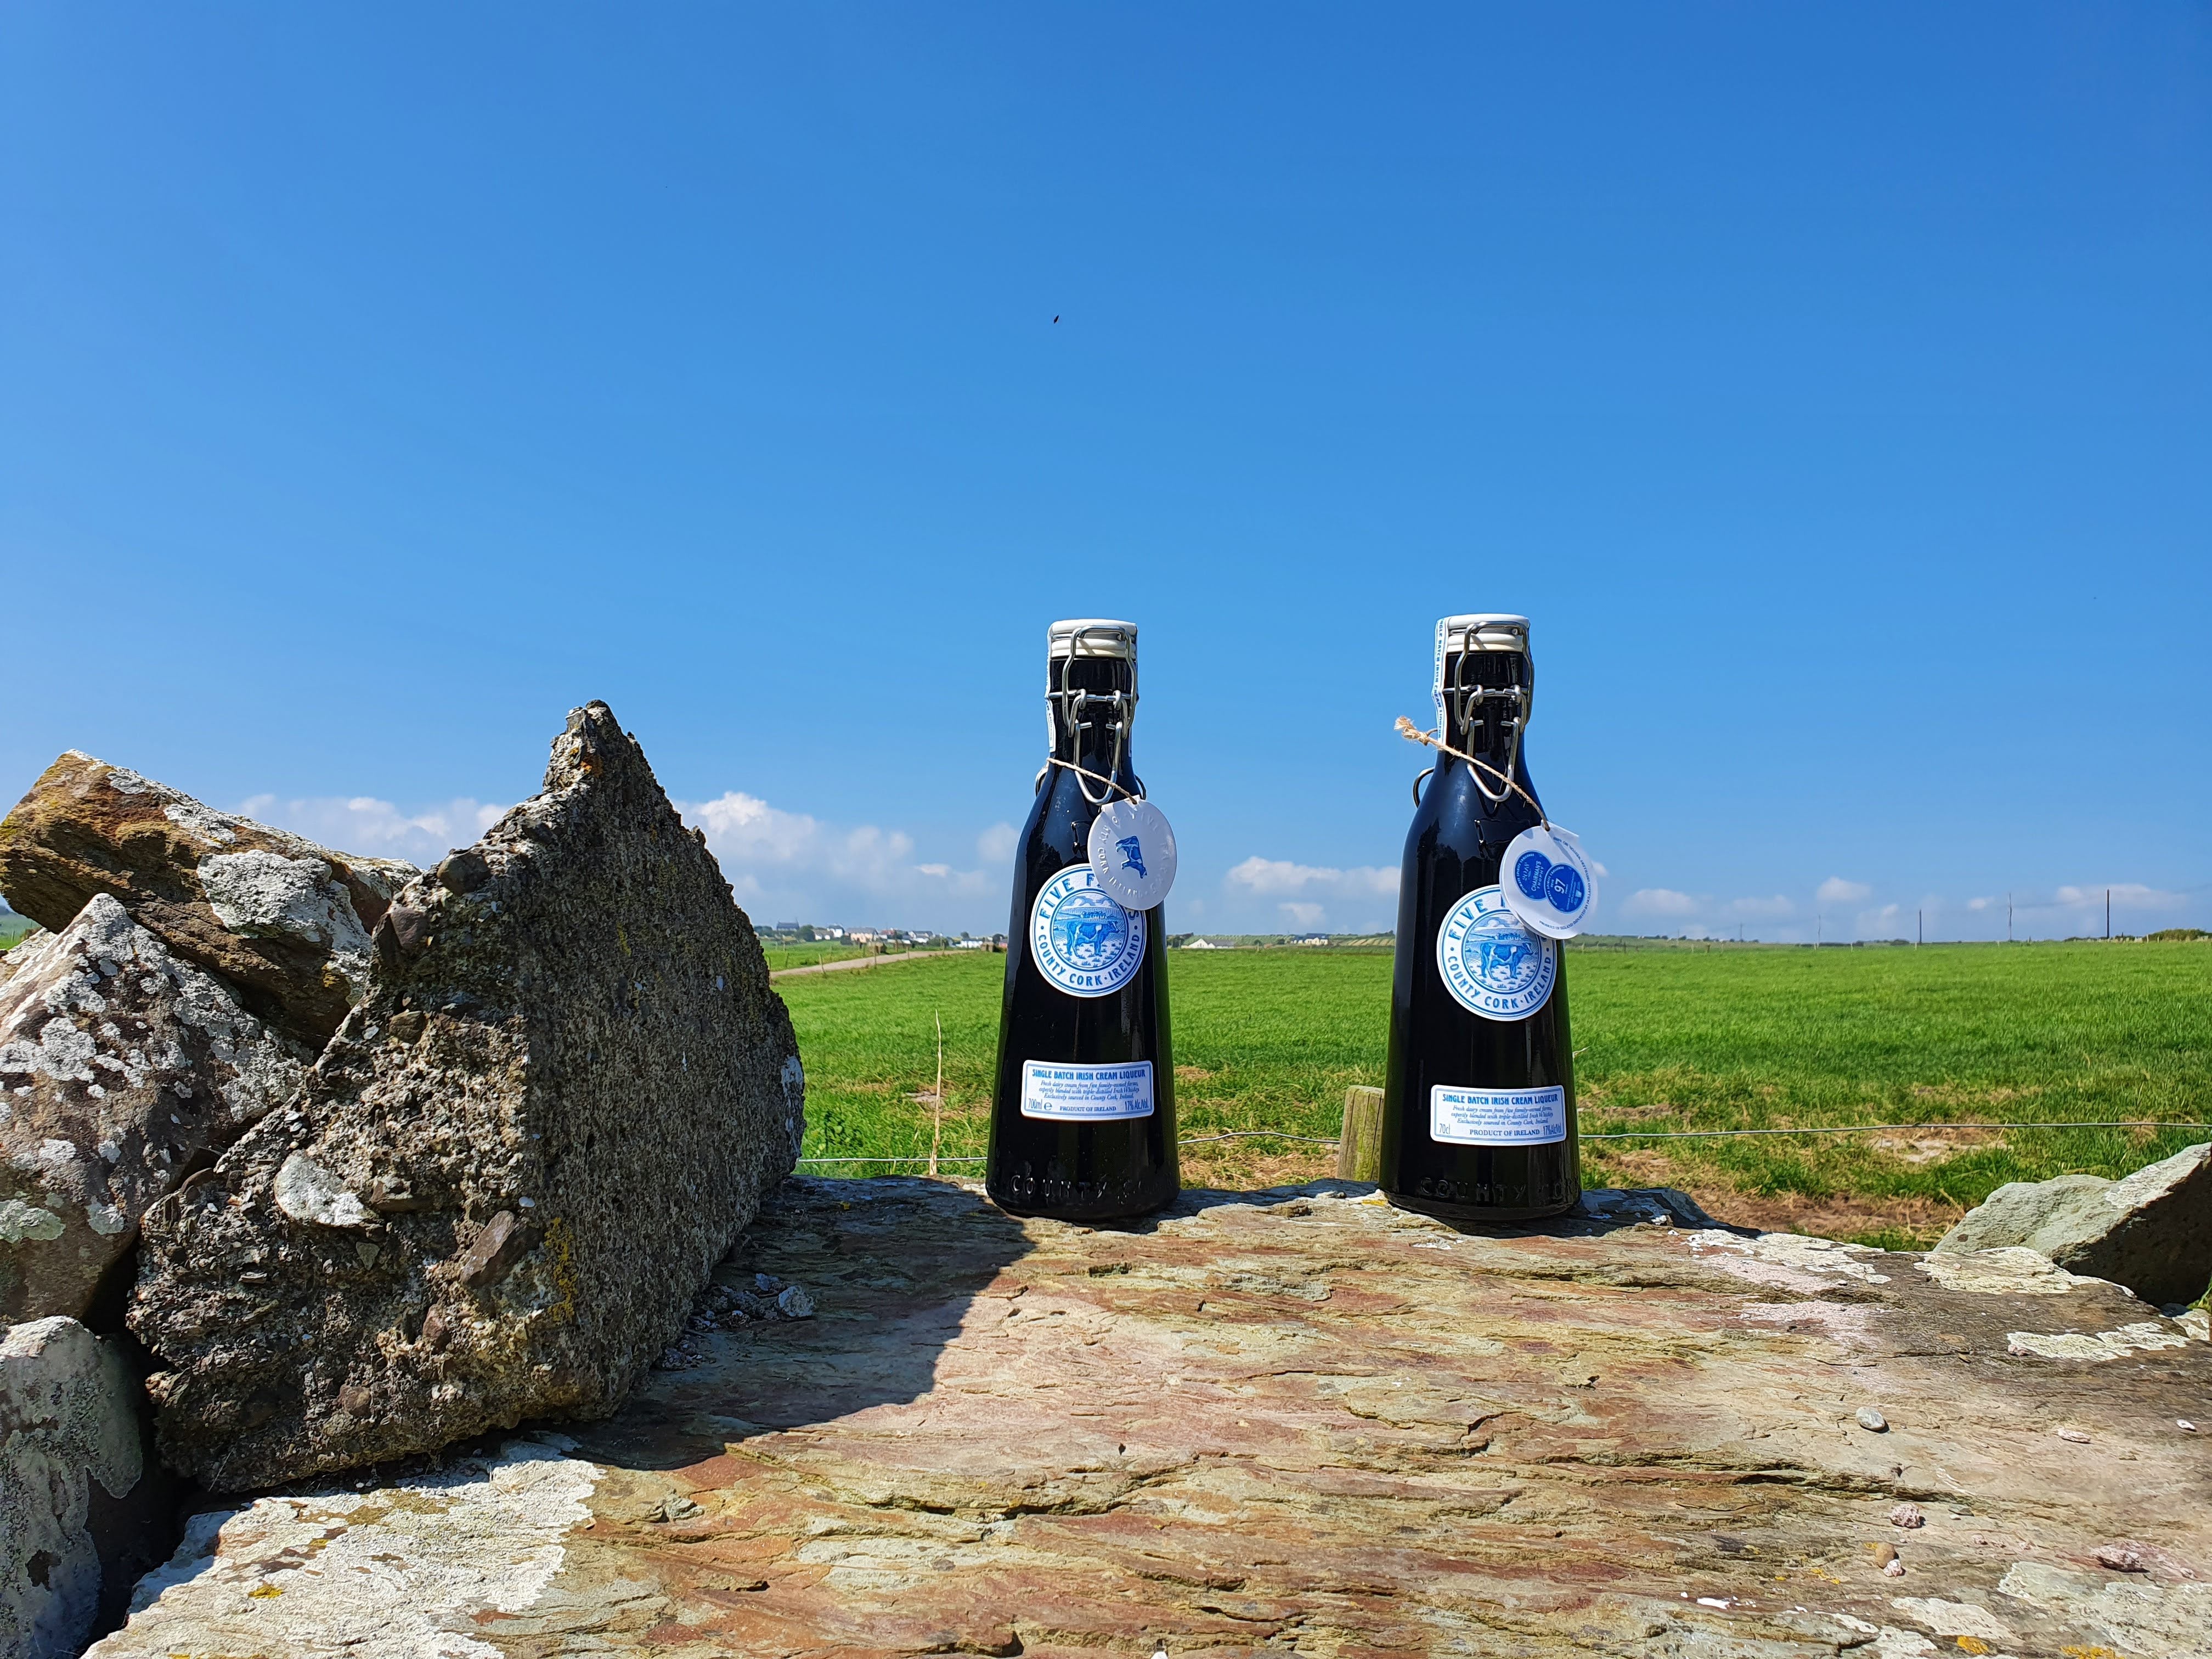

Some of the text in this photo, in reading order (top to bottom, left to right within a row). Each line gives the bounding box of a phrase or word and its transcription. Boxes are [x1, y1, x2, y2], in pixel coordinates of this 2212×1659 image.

[1531, 860, 1541, 891] CHAIRMAN'S
[1554, 878, 1565, 894] 97
[1040, 878, 1074, 919] FIVE
[1449, 899, 1488, 941] FIVE
[1038, 934, 1140, 986] COUNTY CORK IRELAND
[1448, 956, 1551, 1009] COUNTY CORK IRELAND
[1032, 1069, 1146, 1080] SINGLE BATCH IRISH CREAM LIQUEUR
[1028, 1098, 1042, 1110] 700ml
[1125, 1100, 1134, 1111] 17%
[1442, 1093, 1558, 1105] SINGLE BATCH IRISH CREAM LIQUEUR
[1439, 1123, 1450, 1135] 70cl
[1420, 1177, 1528, 1203] COUNTY
